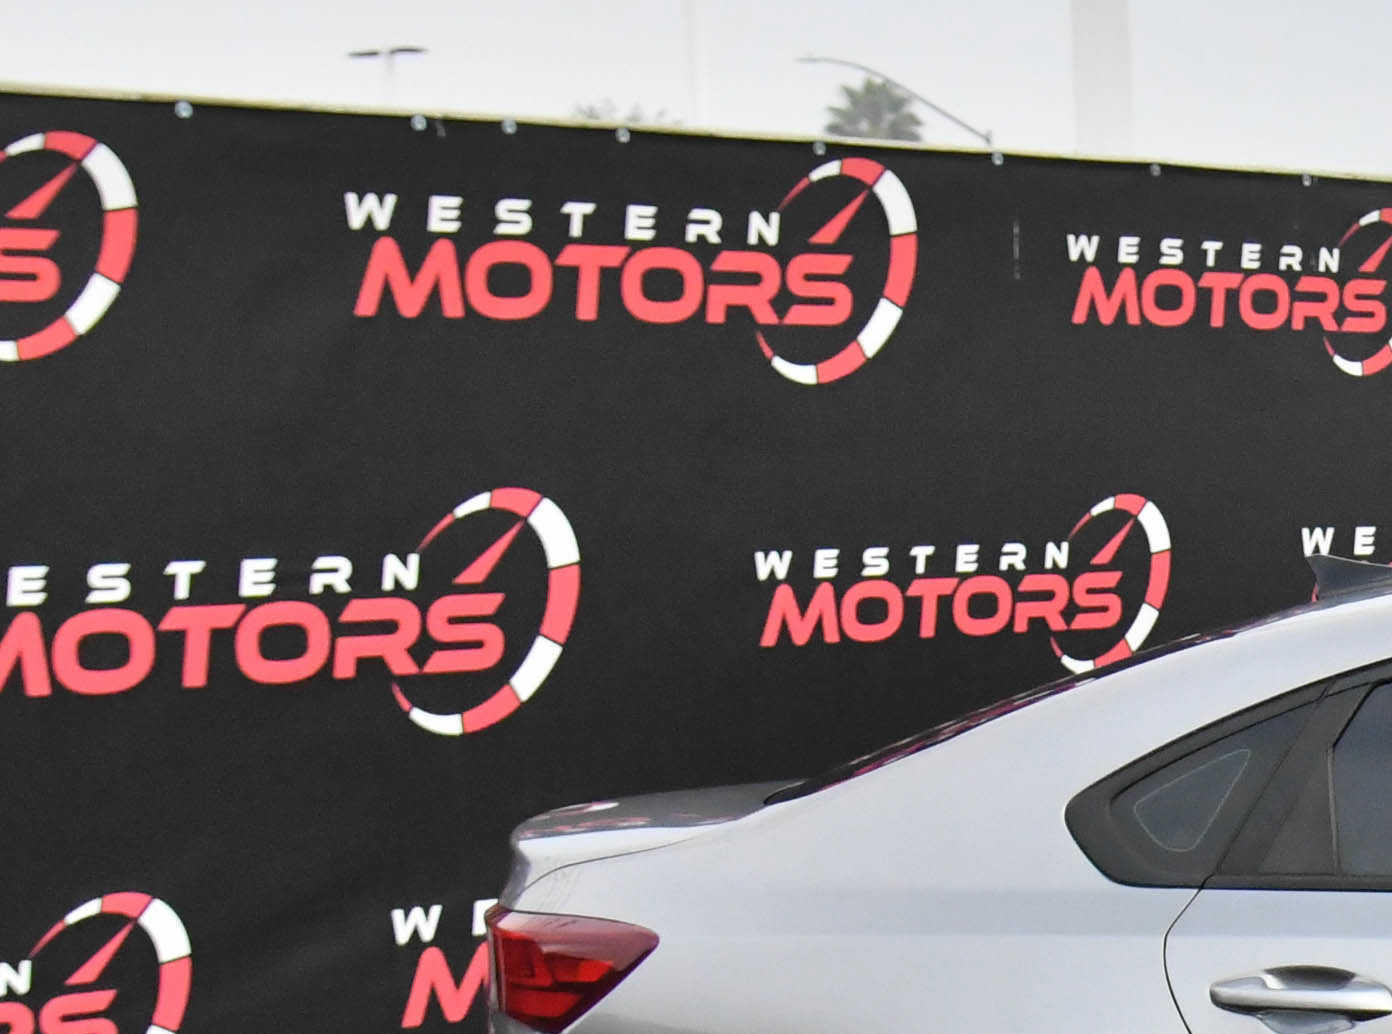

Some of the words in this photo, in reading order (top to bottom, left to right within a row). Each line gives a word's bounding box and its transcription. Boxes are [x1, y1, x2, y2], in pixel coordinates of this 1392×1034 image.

[344, 191, 780, 246] WESTERN
[353, 235, 854, 326] MOTORS
[1066, 233, 1341, 274] WESTERN
[1071, 265, 1388, 333] MOTORS
[754, 540, 1070, 581] WESTERN
[759, 570, 1123, 648] MOTORS
